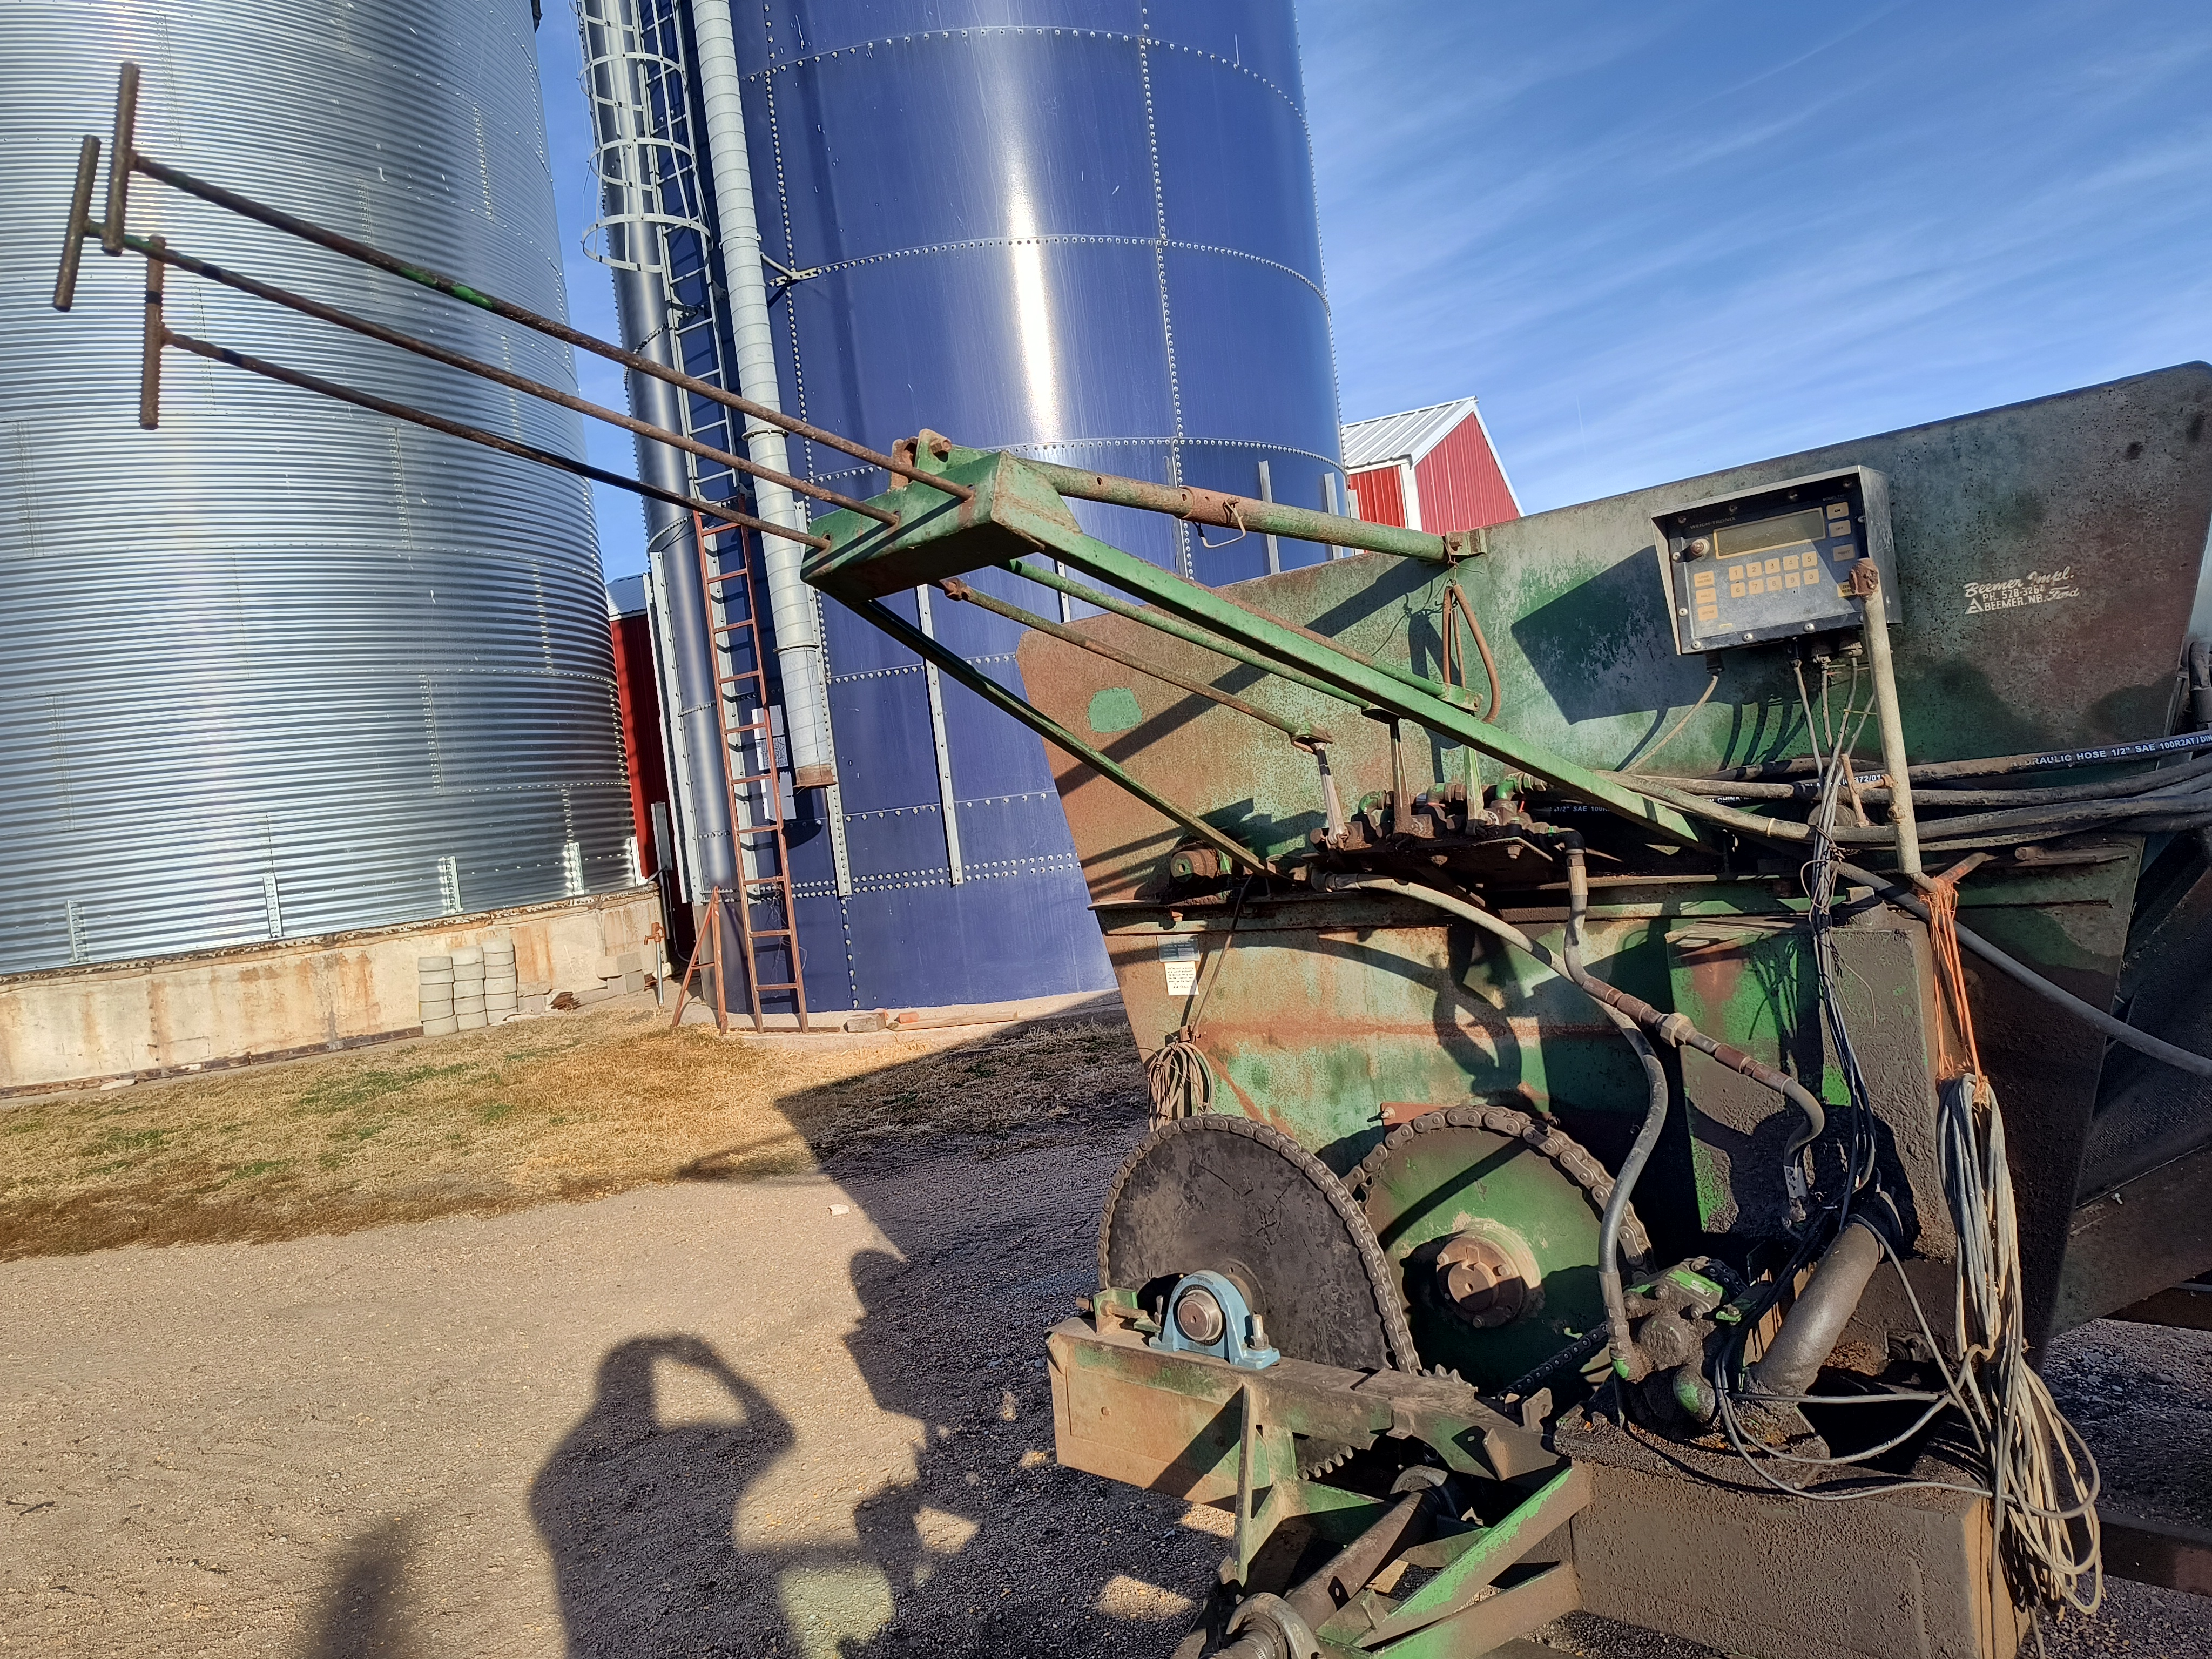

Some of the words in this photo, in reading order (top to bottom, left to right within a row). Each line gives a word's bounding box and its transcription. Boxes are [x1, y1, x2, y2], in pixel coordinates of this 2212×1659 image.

[1963, 578, 2024, 598] Beemer
[2076, 750, 2107, 760] HOSE
[2135, 744, 2156, 753] SAE
